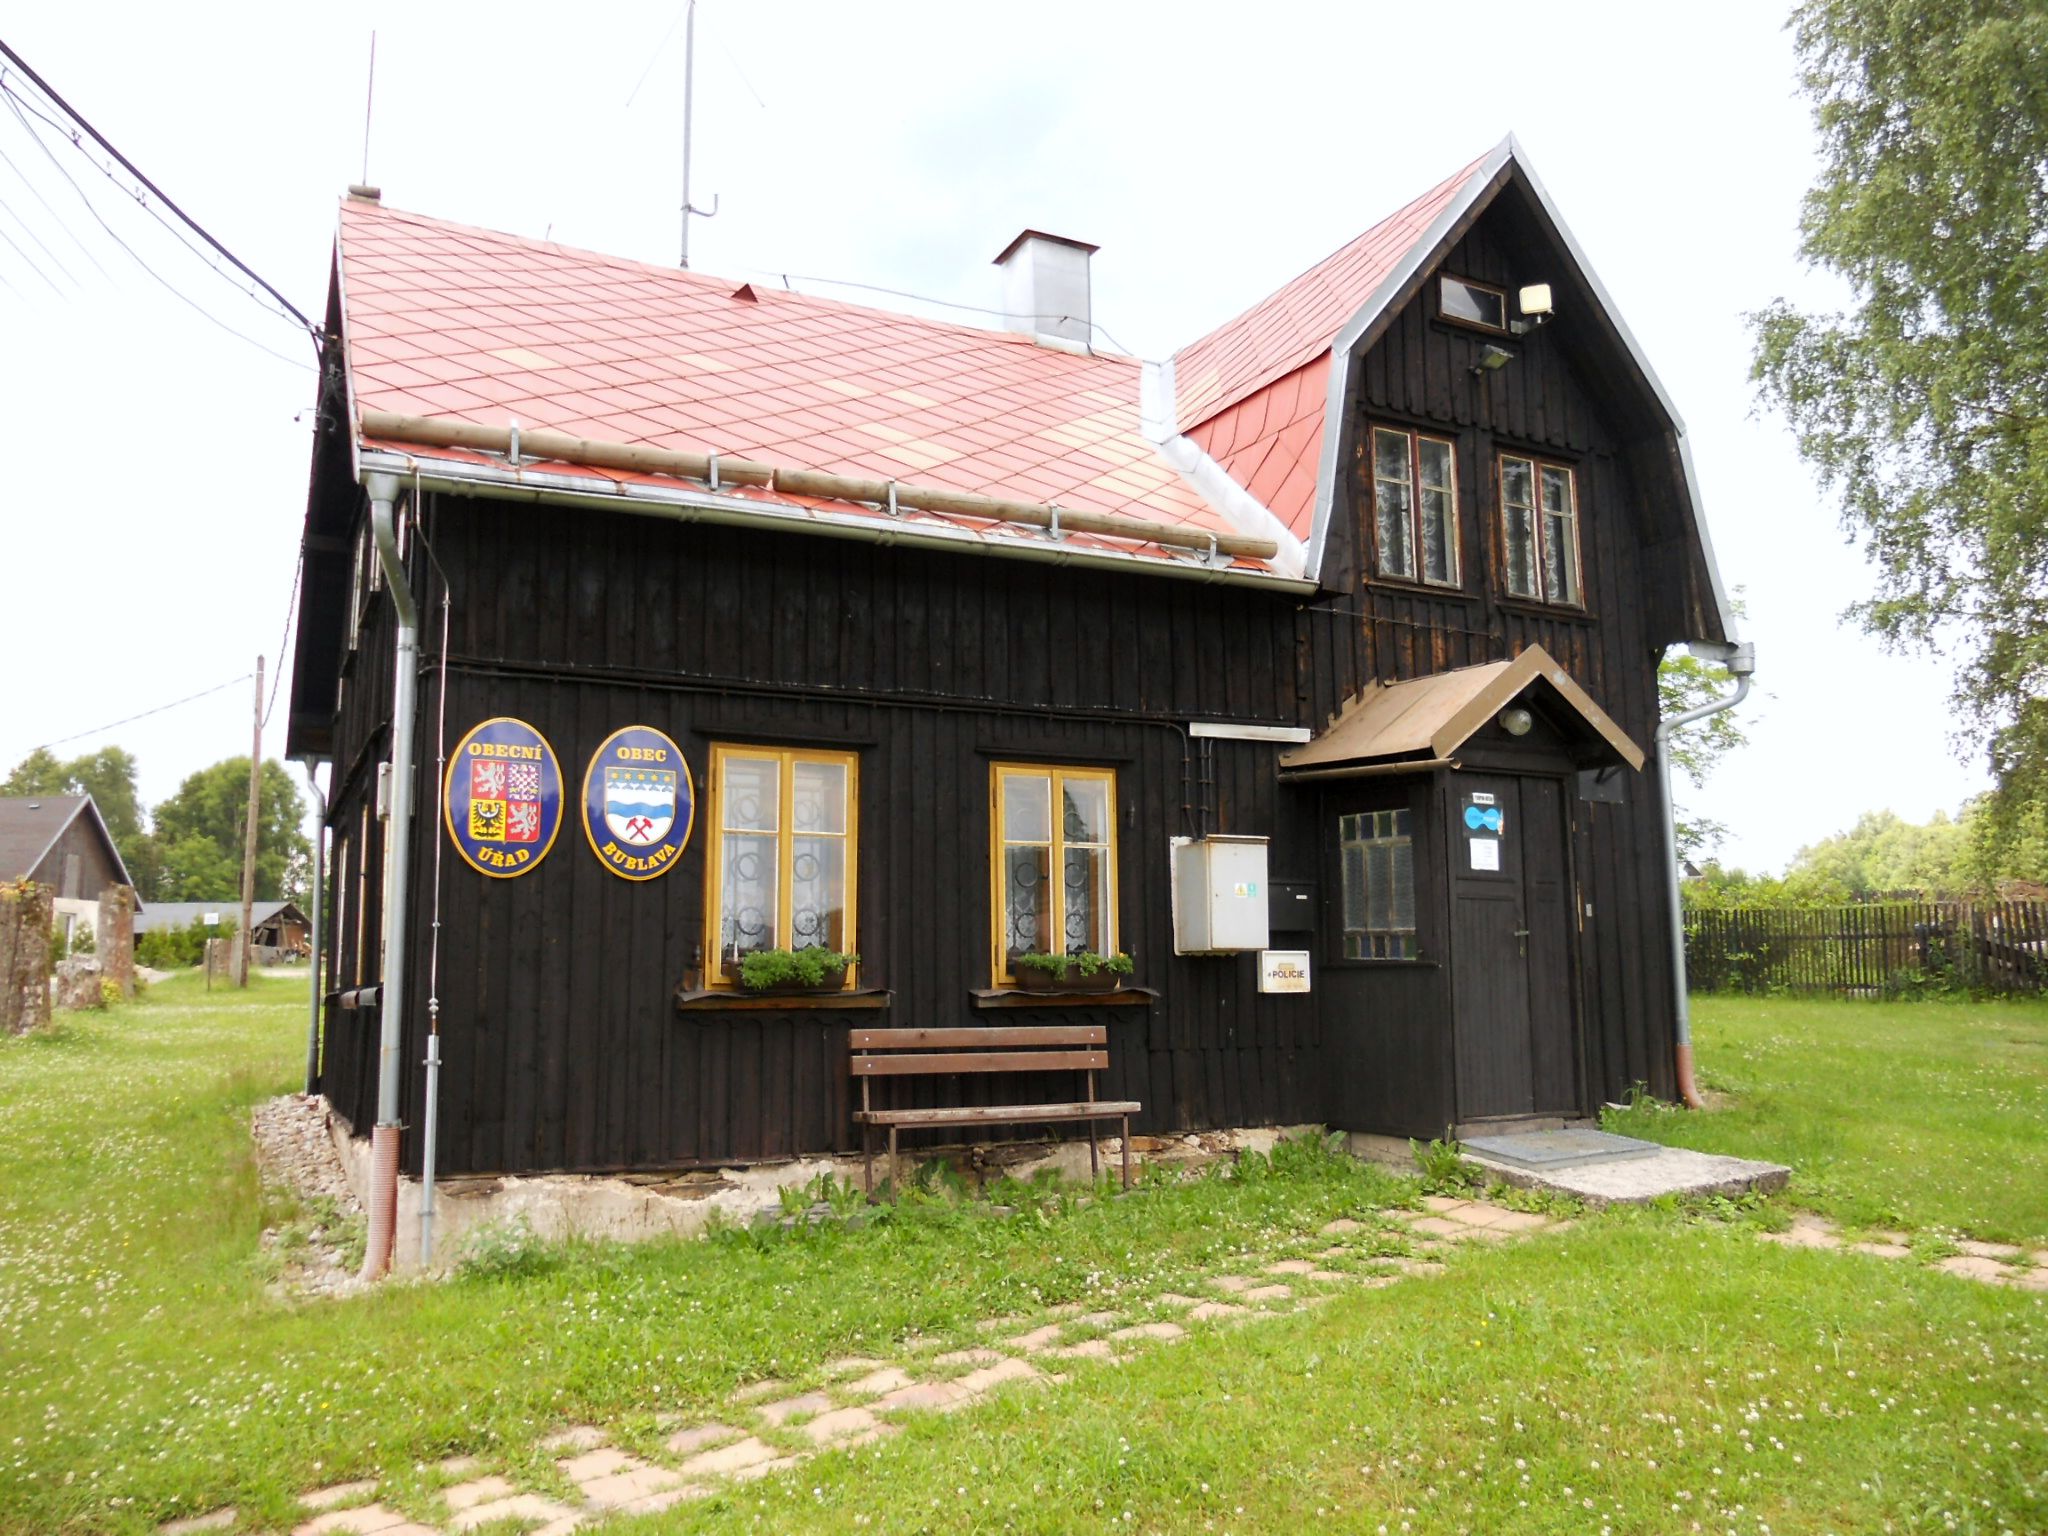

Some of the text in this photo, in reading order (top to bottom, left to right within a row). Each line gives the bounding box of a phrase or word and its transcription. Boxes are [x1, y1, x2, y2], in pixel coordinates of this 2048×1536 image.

[468, 742, 543, 760] OBECNÍ
[616, 746, 667, 762] OBEC
[477, 846, 530, 868] ÚŘAD
[602, 841, 676, 871] BUBLAVA
[1272, 970, 1305, 979] POLICIE
